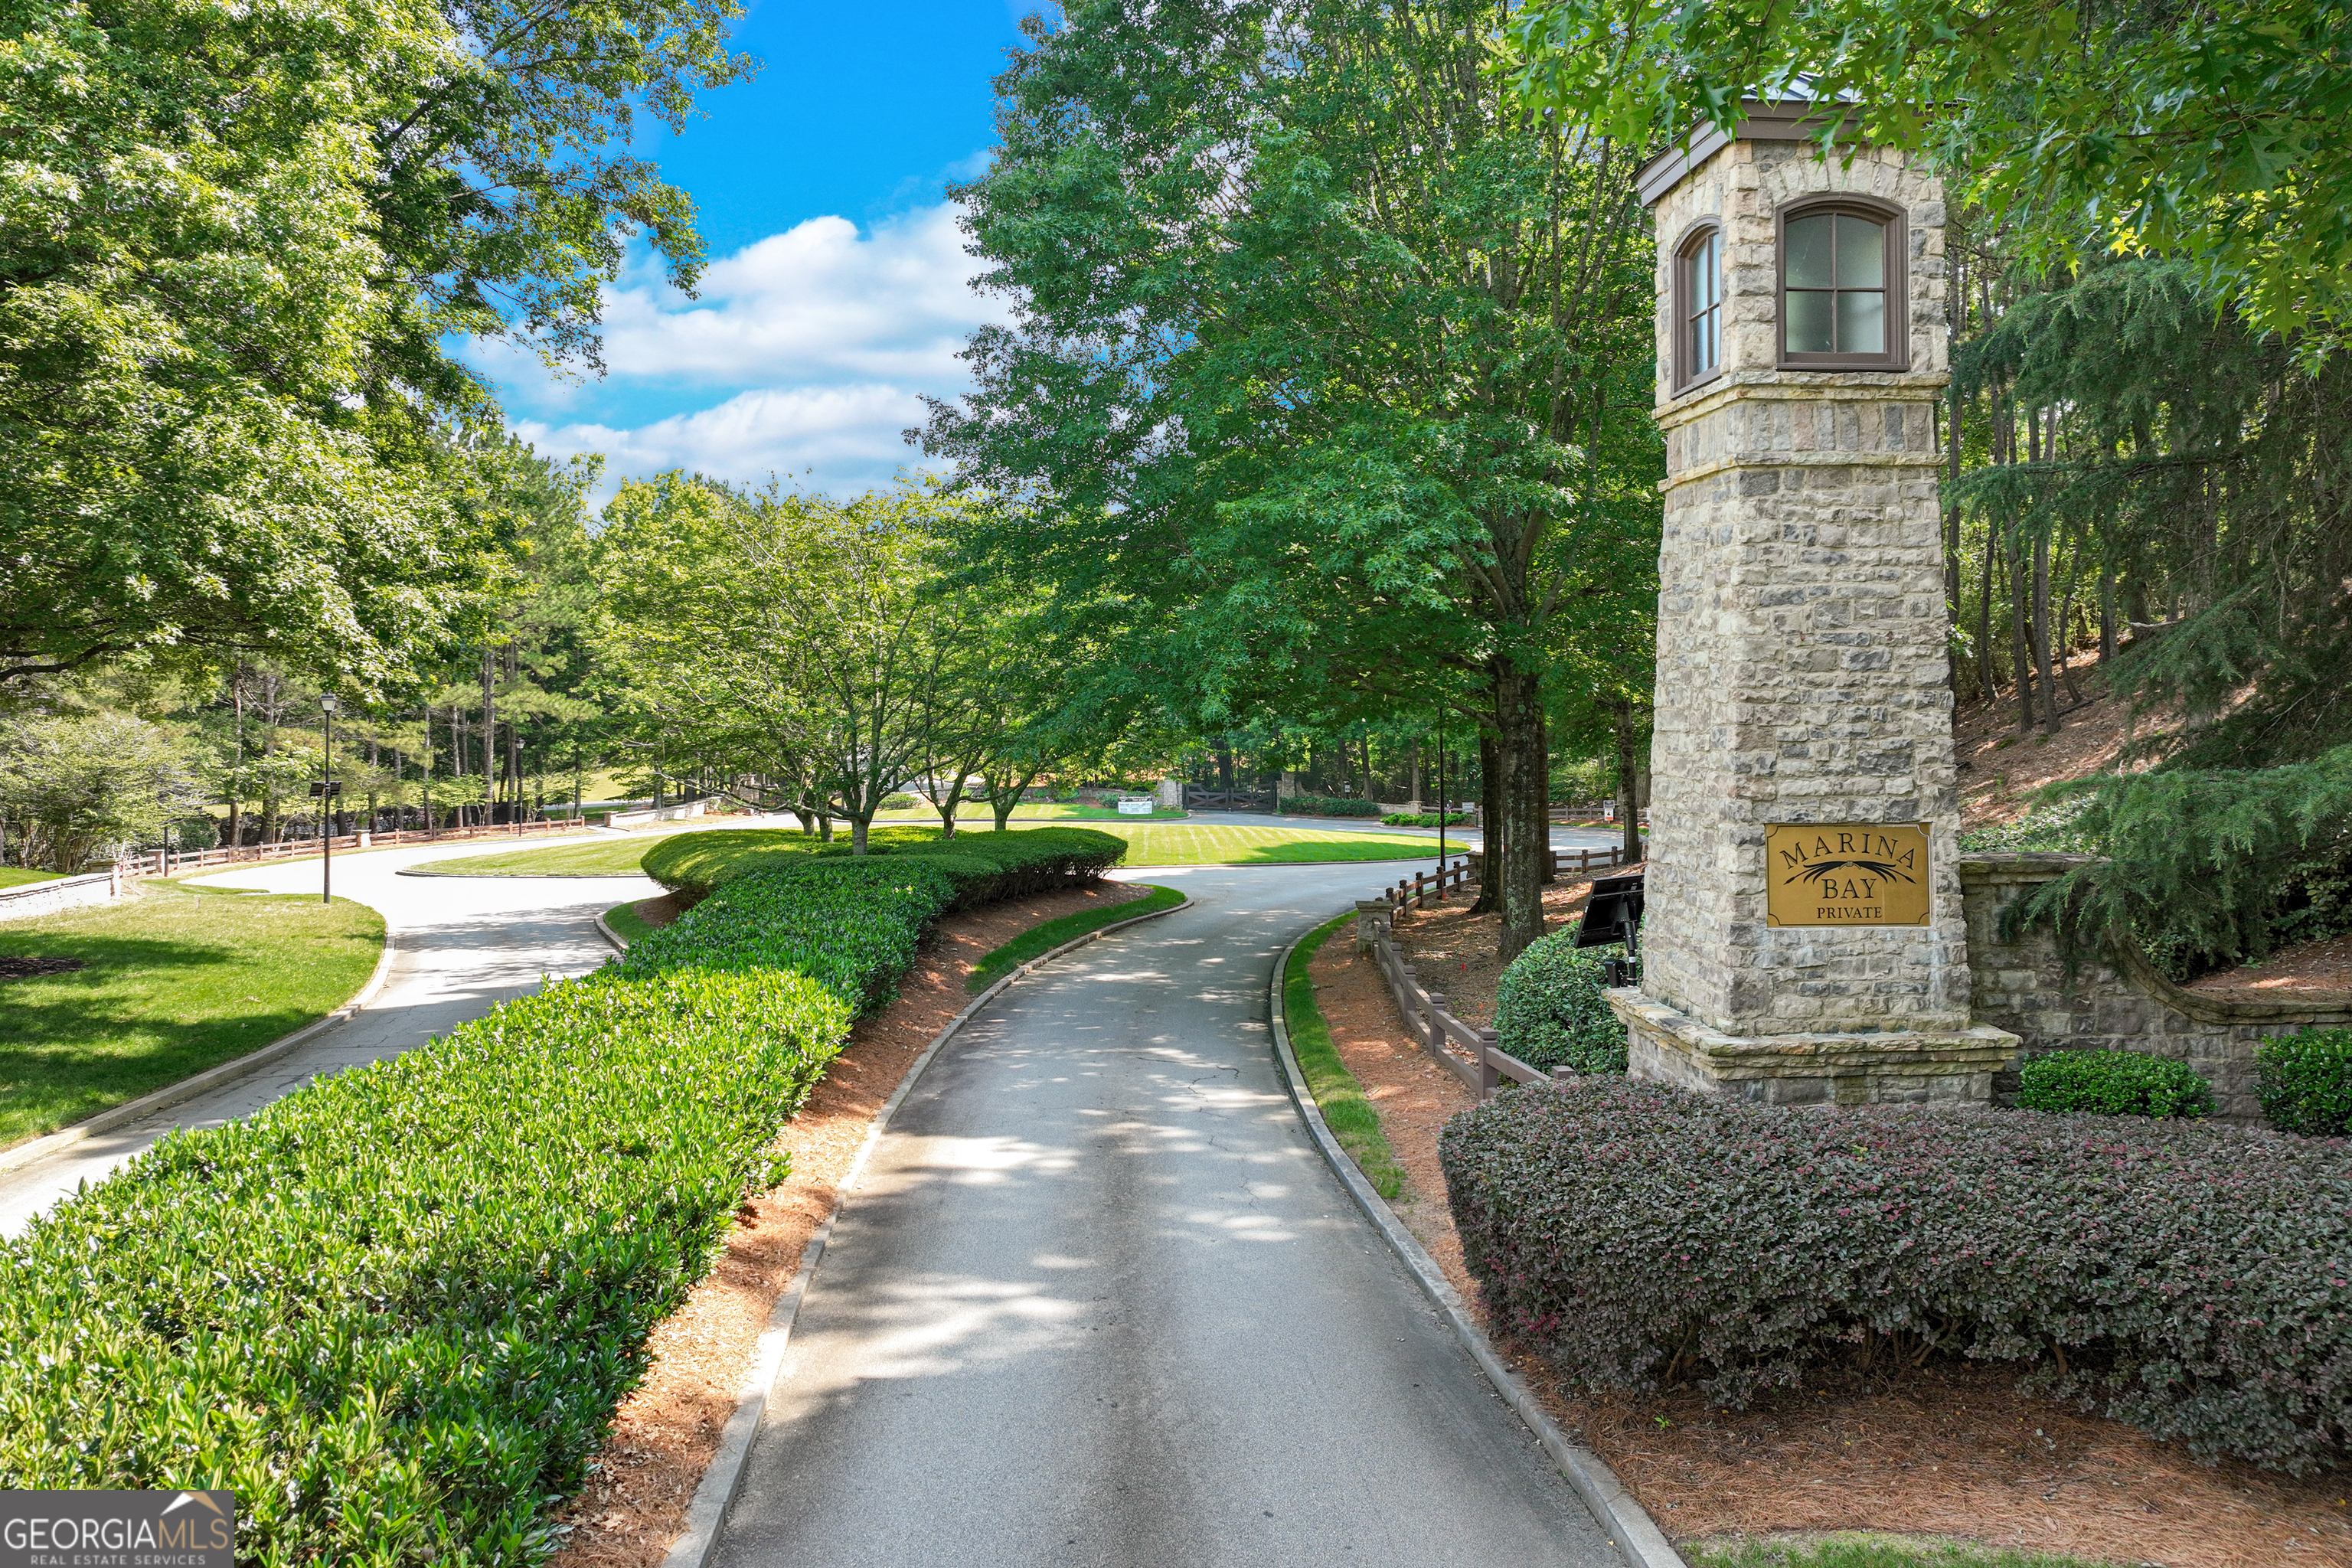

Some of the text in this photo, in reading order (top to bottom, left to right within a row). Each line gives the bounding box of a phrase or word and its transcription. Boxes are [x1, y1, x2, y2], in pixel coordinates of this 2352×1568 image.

[1780, 833, 1915, 870] MARINA
[1821, 879, 1877, 899] BAY
[1817, 906, 1883, 919] PRIVATE
